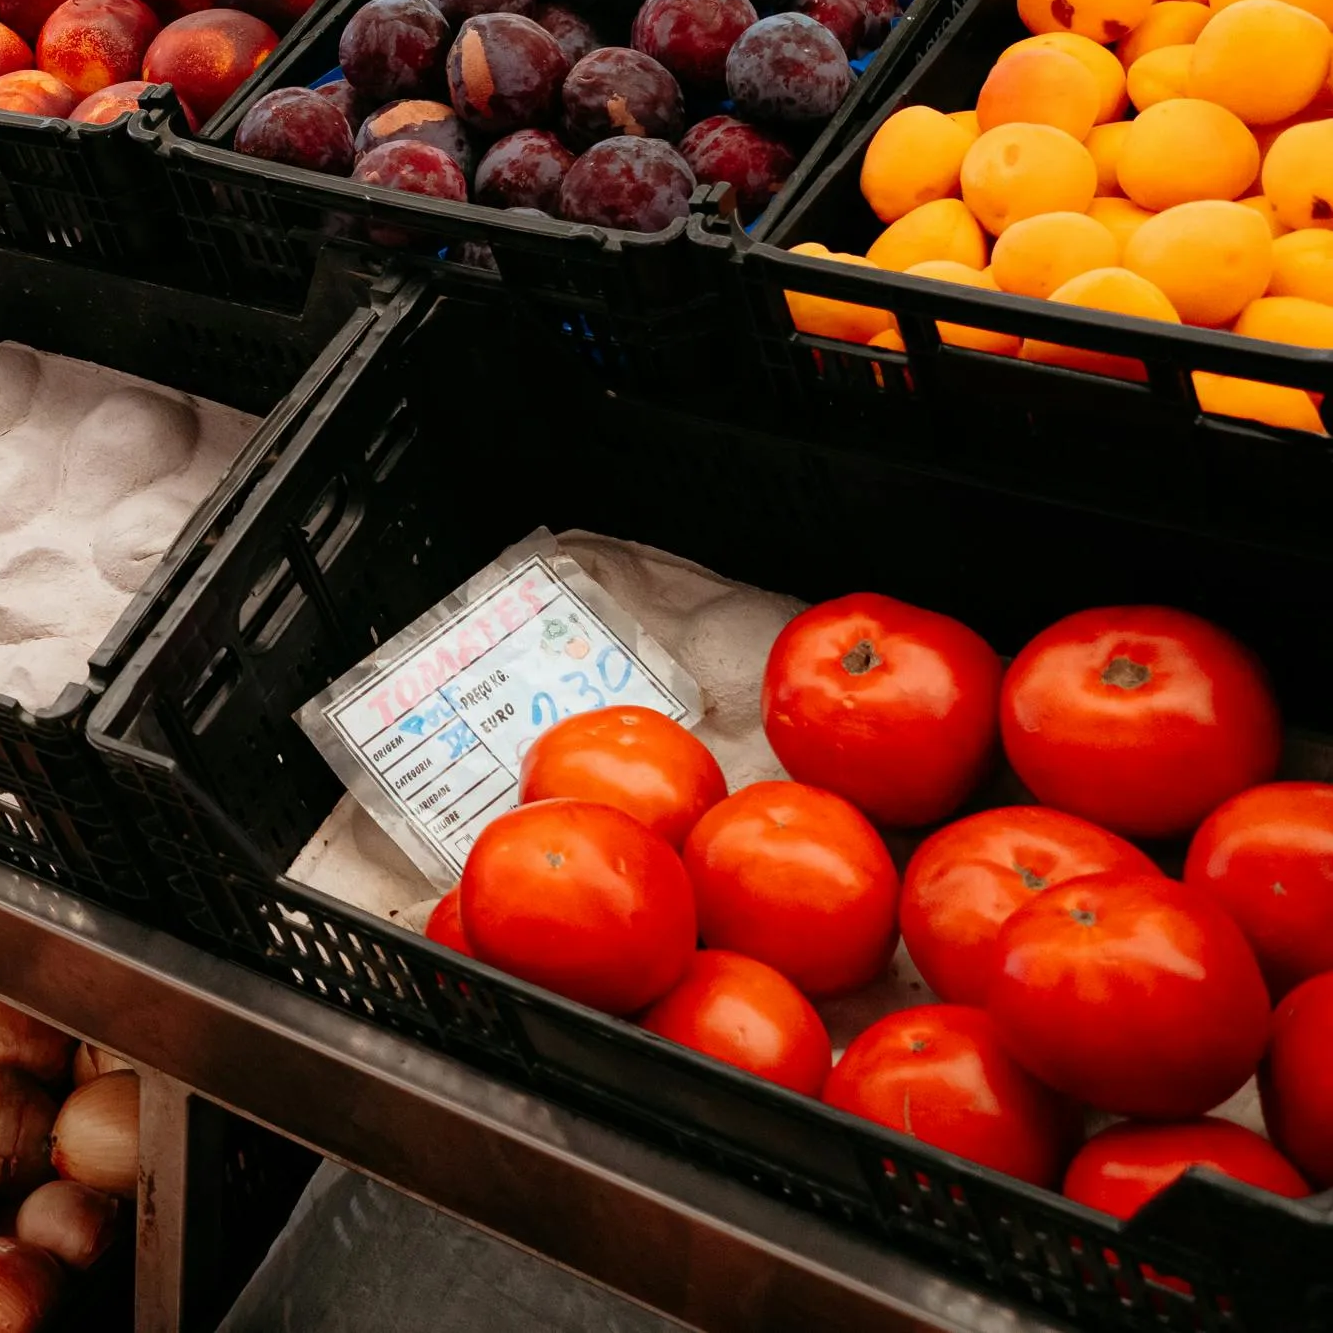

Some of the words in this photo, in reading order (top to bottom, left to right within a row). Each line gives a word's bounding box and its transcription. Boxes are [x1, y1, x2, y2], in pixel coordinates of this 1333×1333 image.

[367, 579, 546, 726] TOMATES
[479, 702, 515, 734] EURO
[373, 734, 404, 763] ORIGEM
[394, 757, 433, 790] CATEGORIA
[413, 783, 452, 816] VARIEDADE
